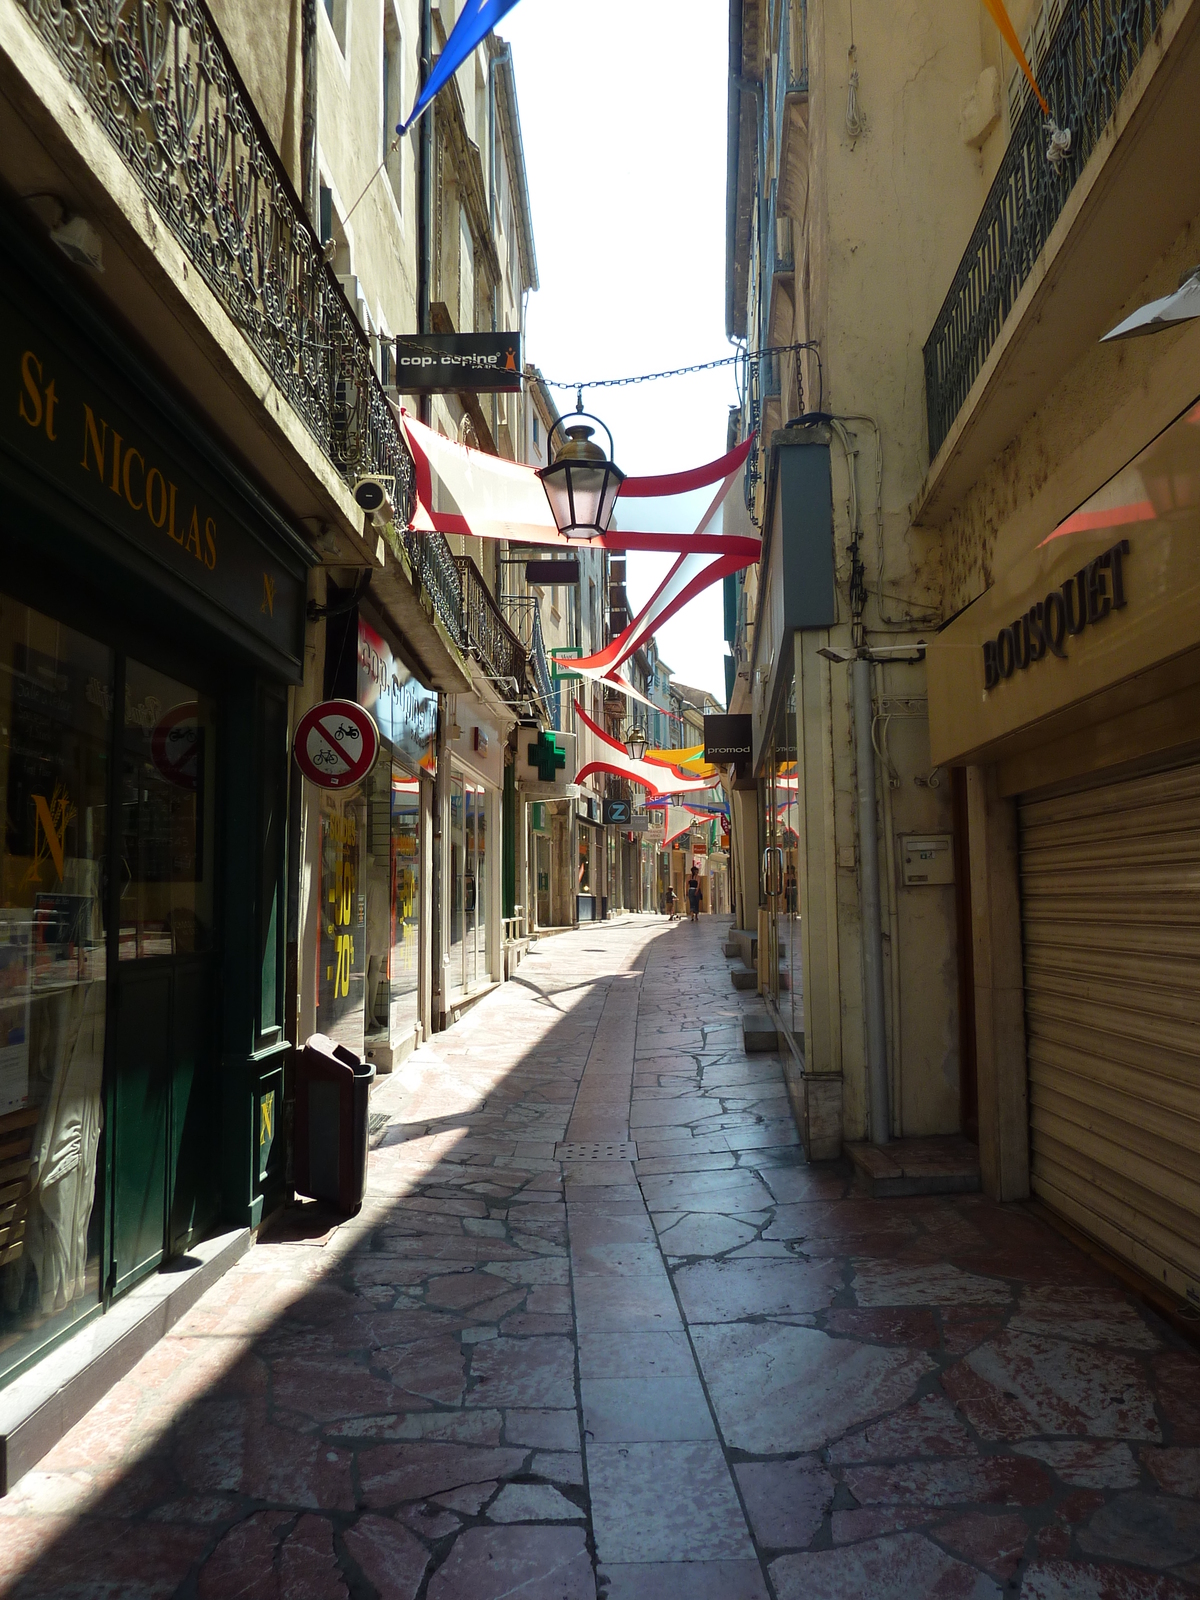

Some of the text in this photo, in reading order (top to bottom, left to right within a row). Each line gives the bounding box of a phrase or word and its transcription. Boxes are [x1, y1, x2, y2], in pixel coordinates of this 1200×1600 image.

[400, 356, 437, 367] cop.
[20, 351, 217, 570] St NICOLAS
[982, 539, 1130, 690] BOUSQUET
[707, 746, 751, 755] promod
[329, 814, 356, 847] SOLDES
